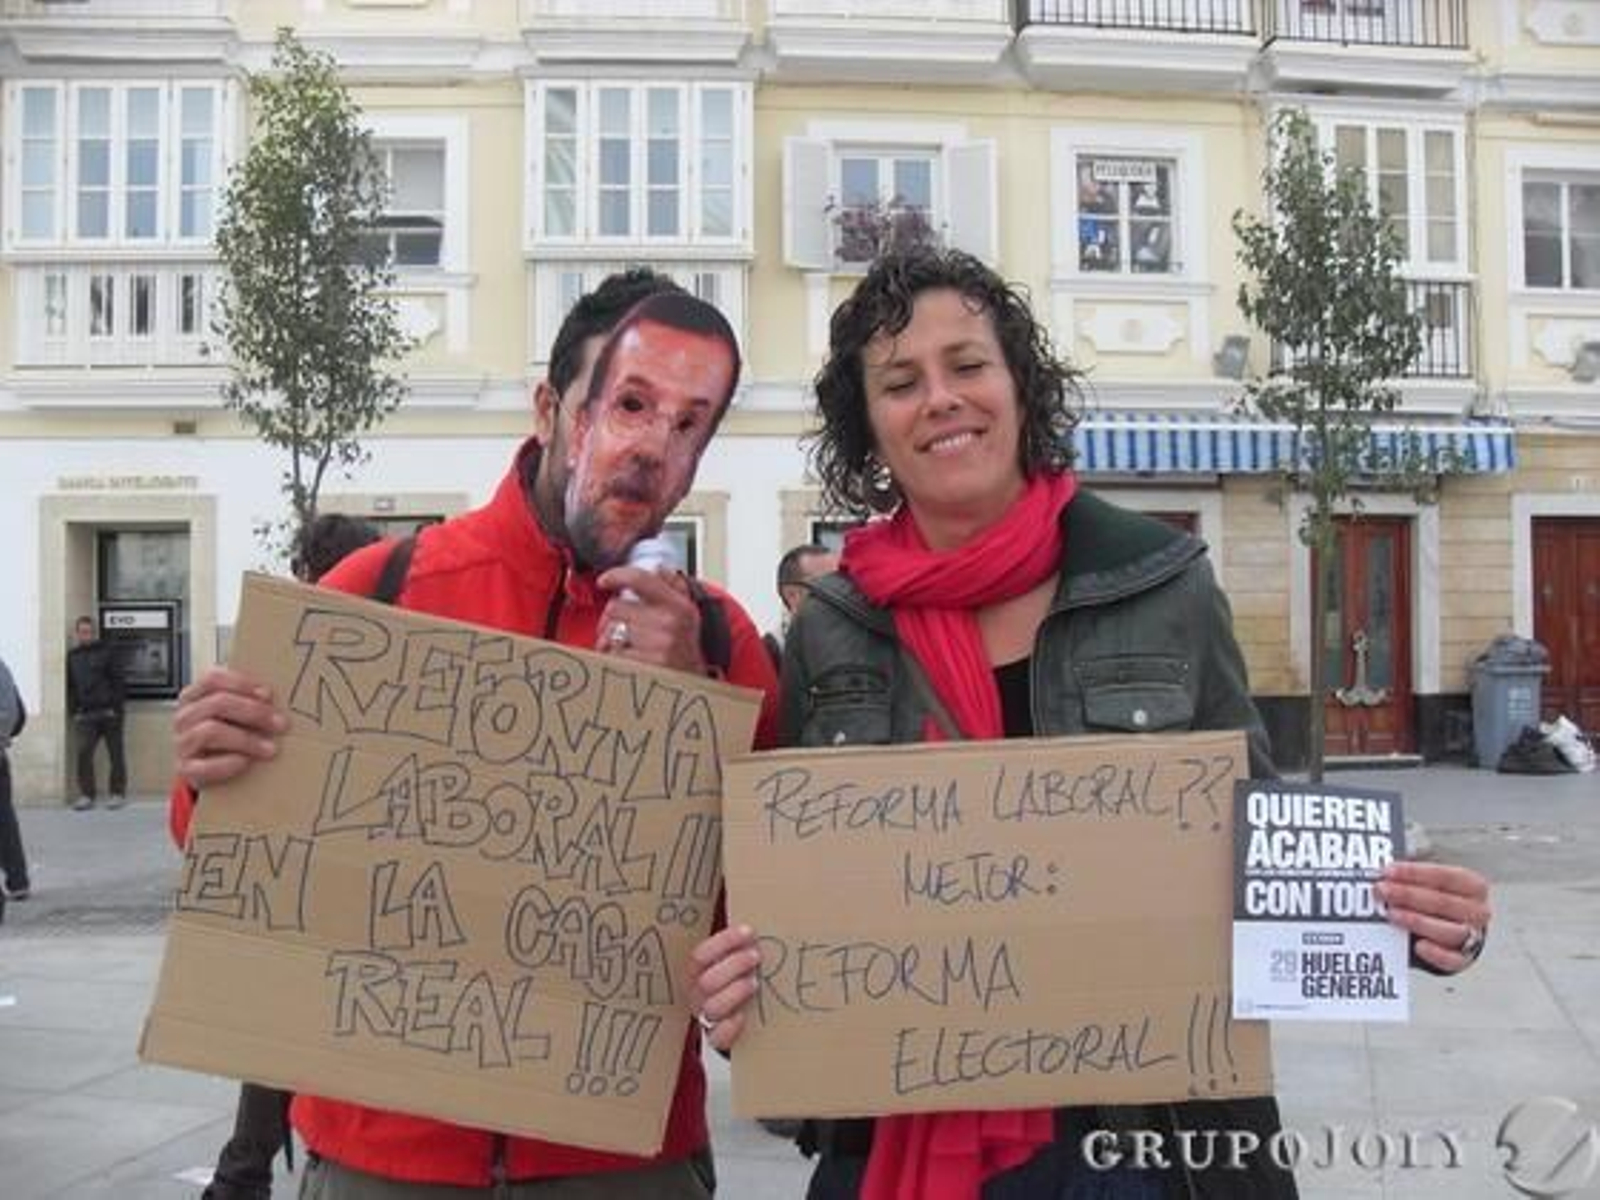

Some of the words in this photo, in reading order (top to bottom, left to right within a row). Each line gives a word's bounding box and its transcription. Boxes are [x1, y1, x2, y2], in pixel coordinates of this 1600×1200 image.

[289, 609, 723, 801] REFORMA
[754, 767, 963, 844] REFORMA
[1247, 792, 1391, 833] QUIEREN
[1247, 829, 1395, 869] ACABAR
[176, 832, 314, 932] EN
[369, 859, 466, 950] LA
[1245, 880, 1311, 916] CON
[754, 934, 1021, 1027] REFORMA
[1301, 952, 1385, 974] HUELGA
[1301, 975, 1399, 999] GENERAL
